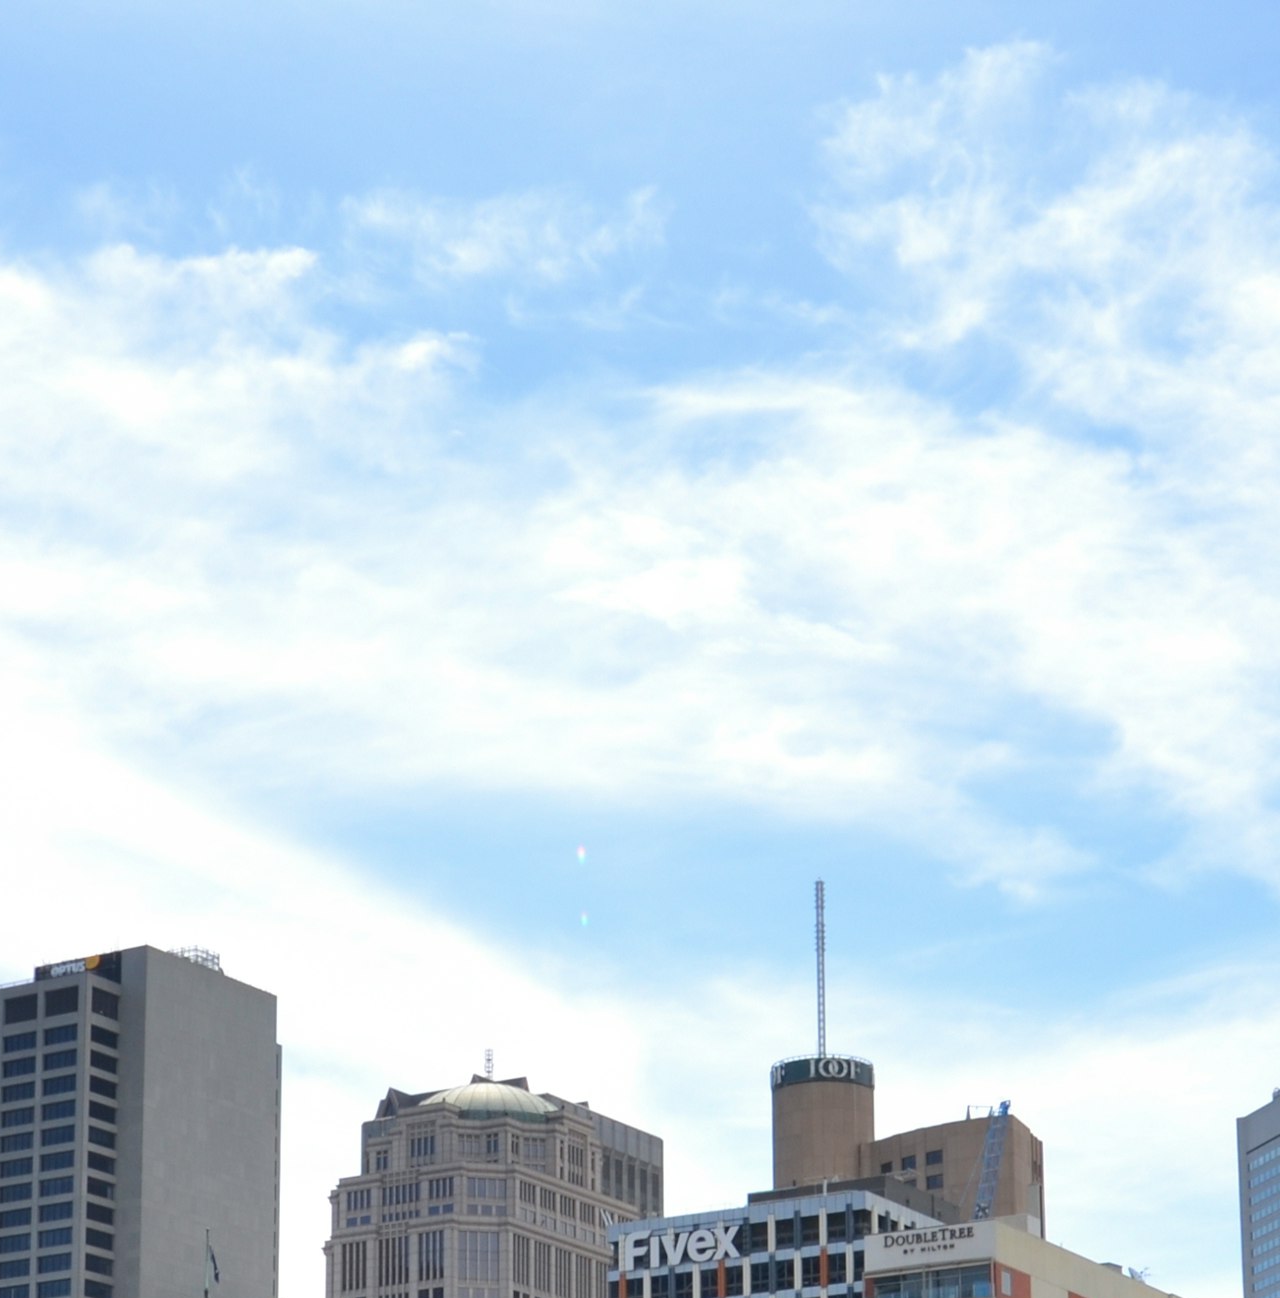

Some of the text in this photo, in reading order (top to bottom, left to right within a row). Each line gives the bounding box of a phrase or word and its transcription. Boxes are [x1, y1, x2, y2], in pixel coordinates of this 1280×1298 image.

[50, 961, 86, 977] OPTUS
[810, 1057, 860, 1079] IOOF
[625, 1226, 740, 1271] Fivex
